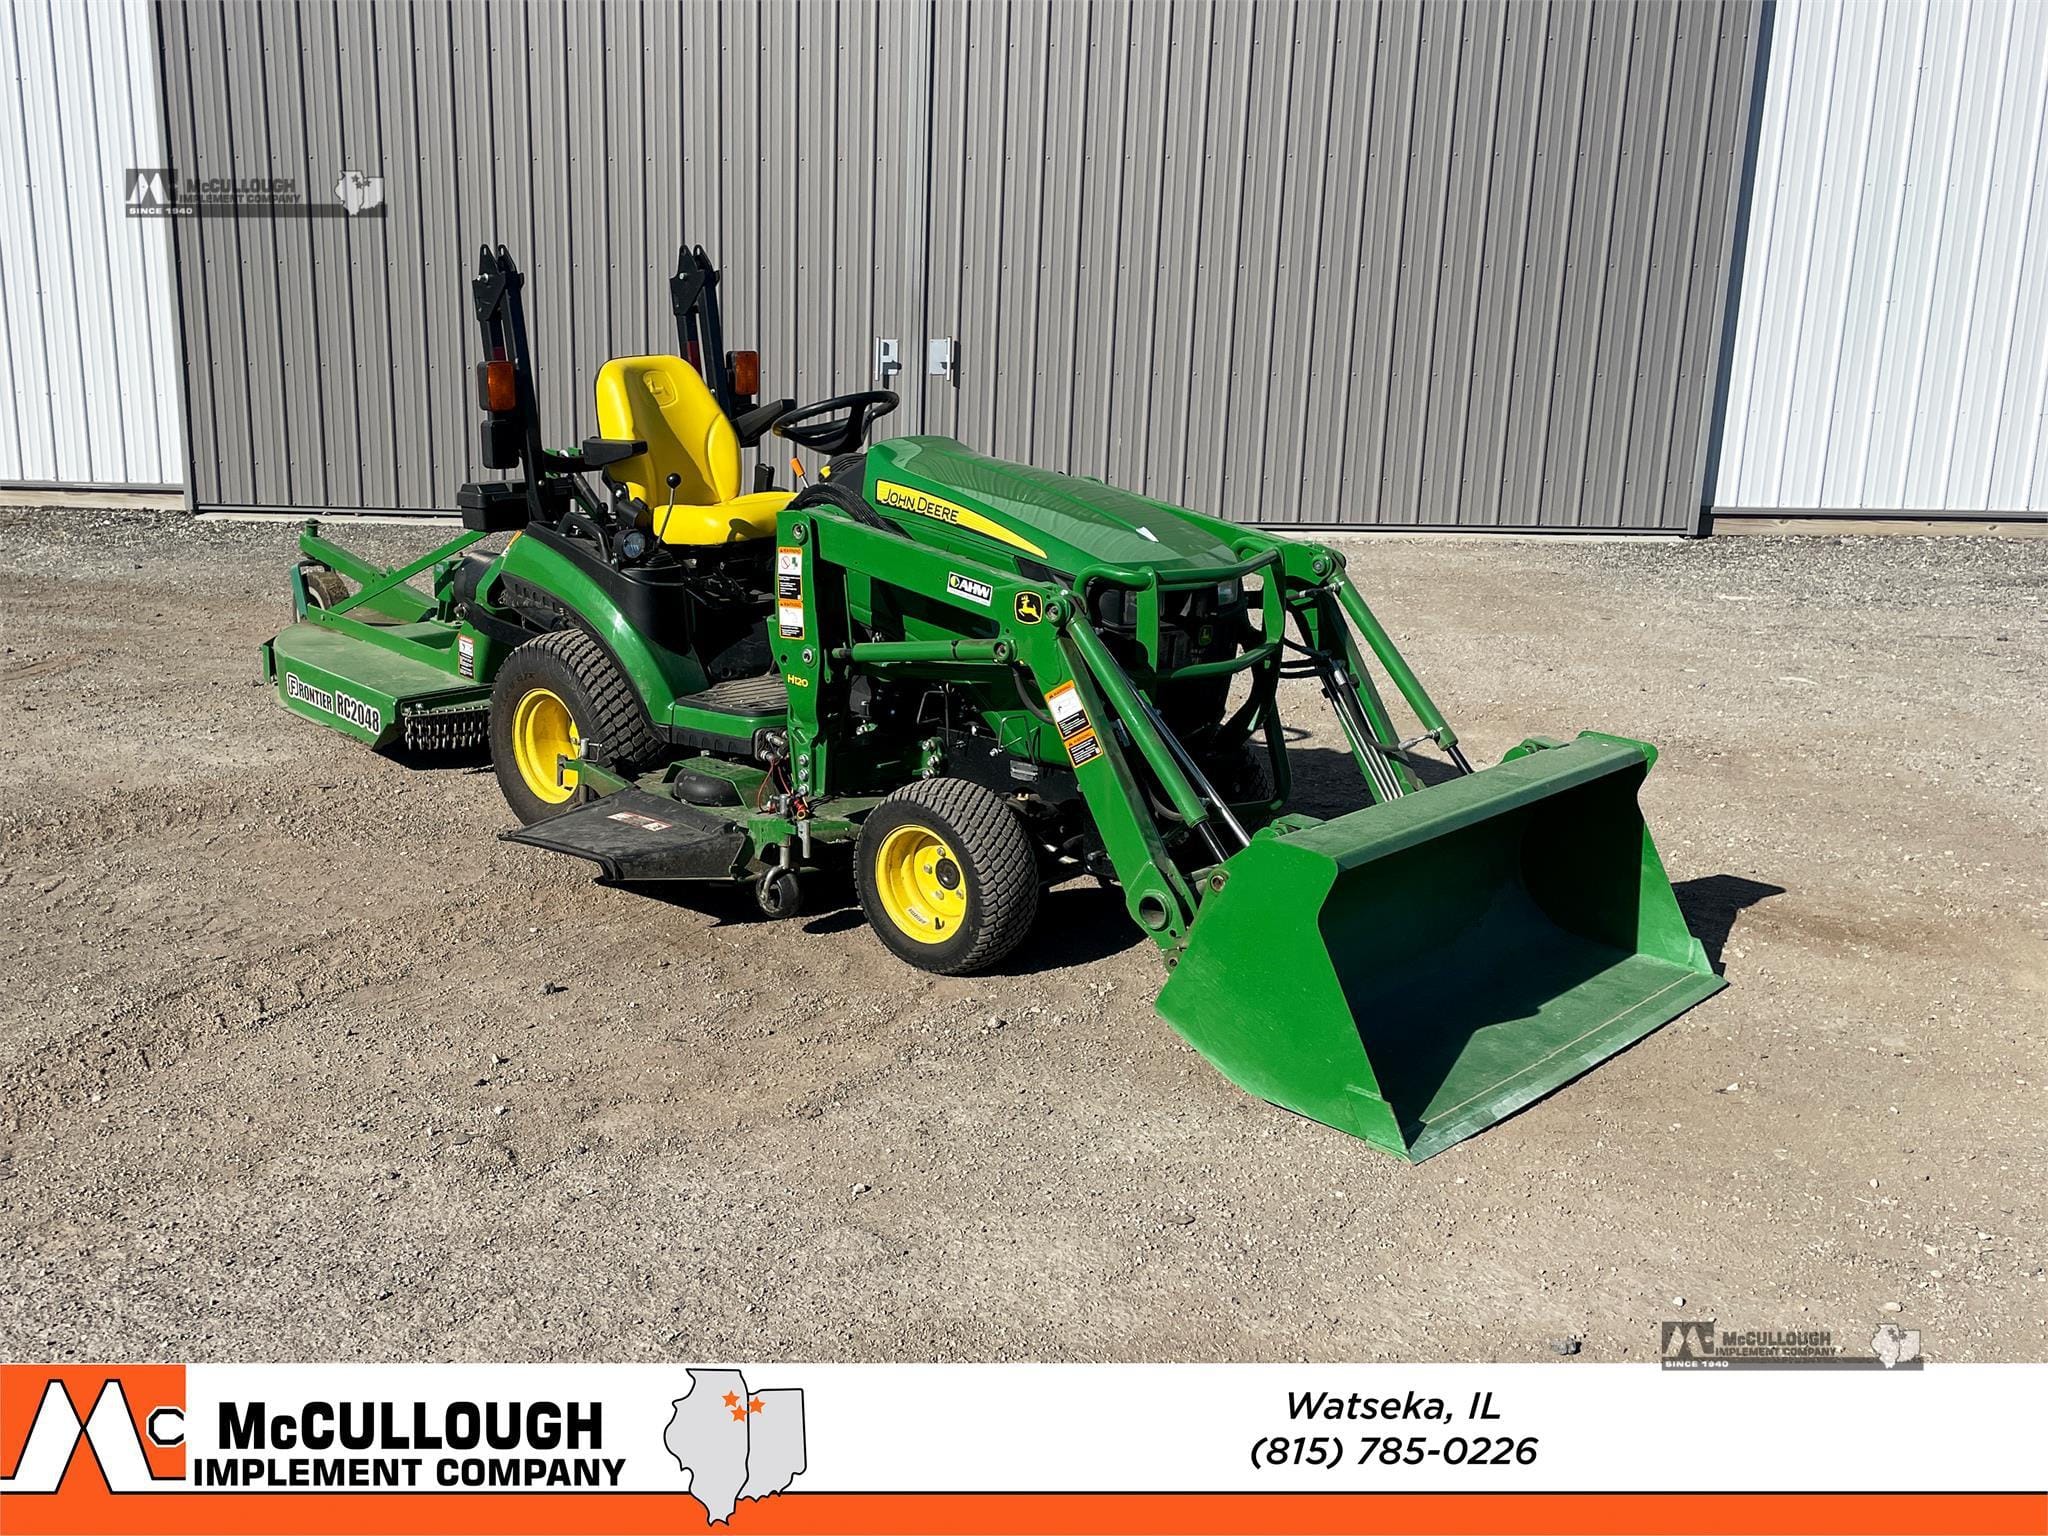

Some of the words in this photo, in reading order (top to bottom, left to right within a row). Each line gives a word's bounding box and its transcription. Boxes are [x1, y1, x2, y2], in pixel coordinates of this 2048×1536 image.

[883, 488, 916, 509] JOHN
[917, 496, 959, 523] DEERE
[959, 579, 991, 599] AHW
[337, 693, 380, 733] RC2048
